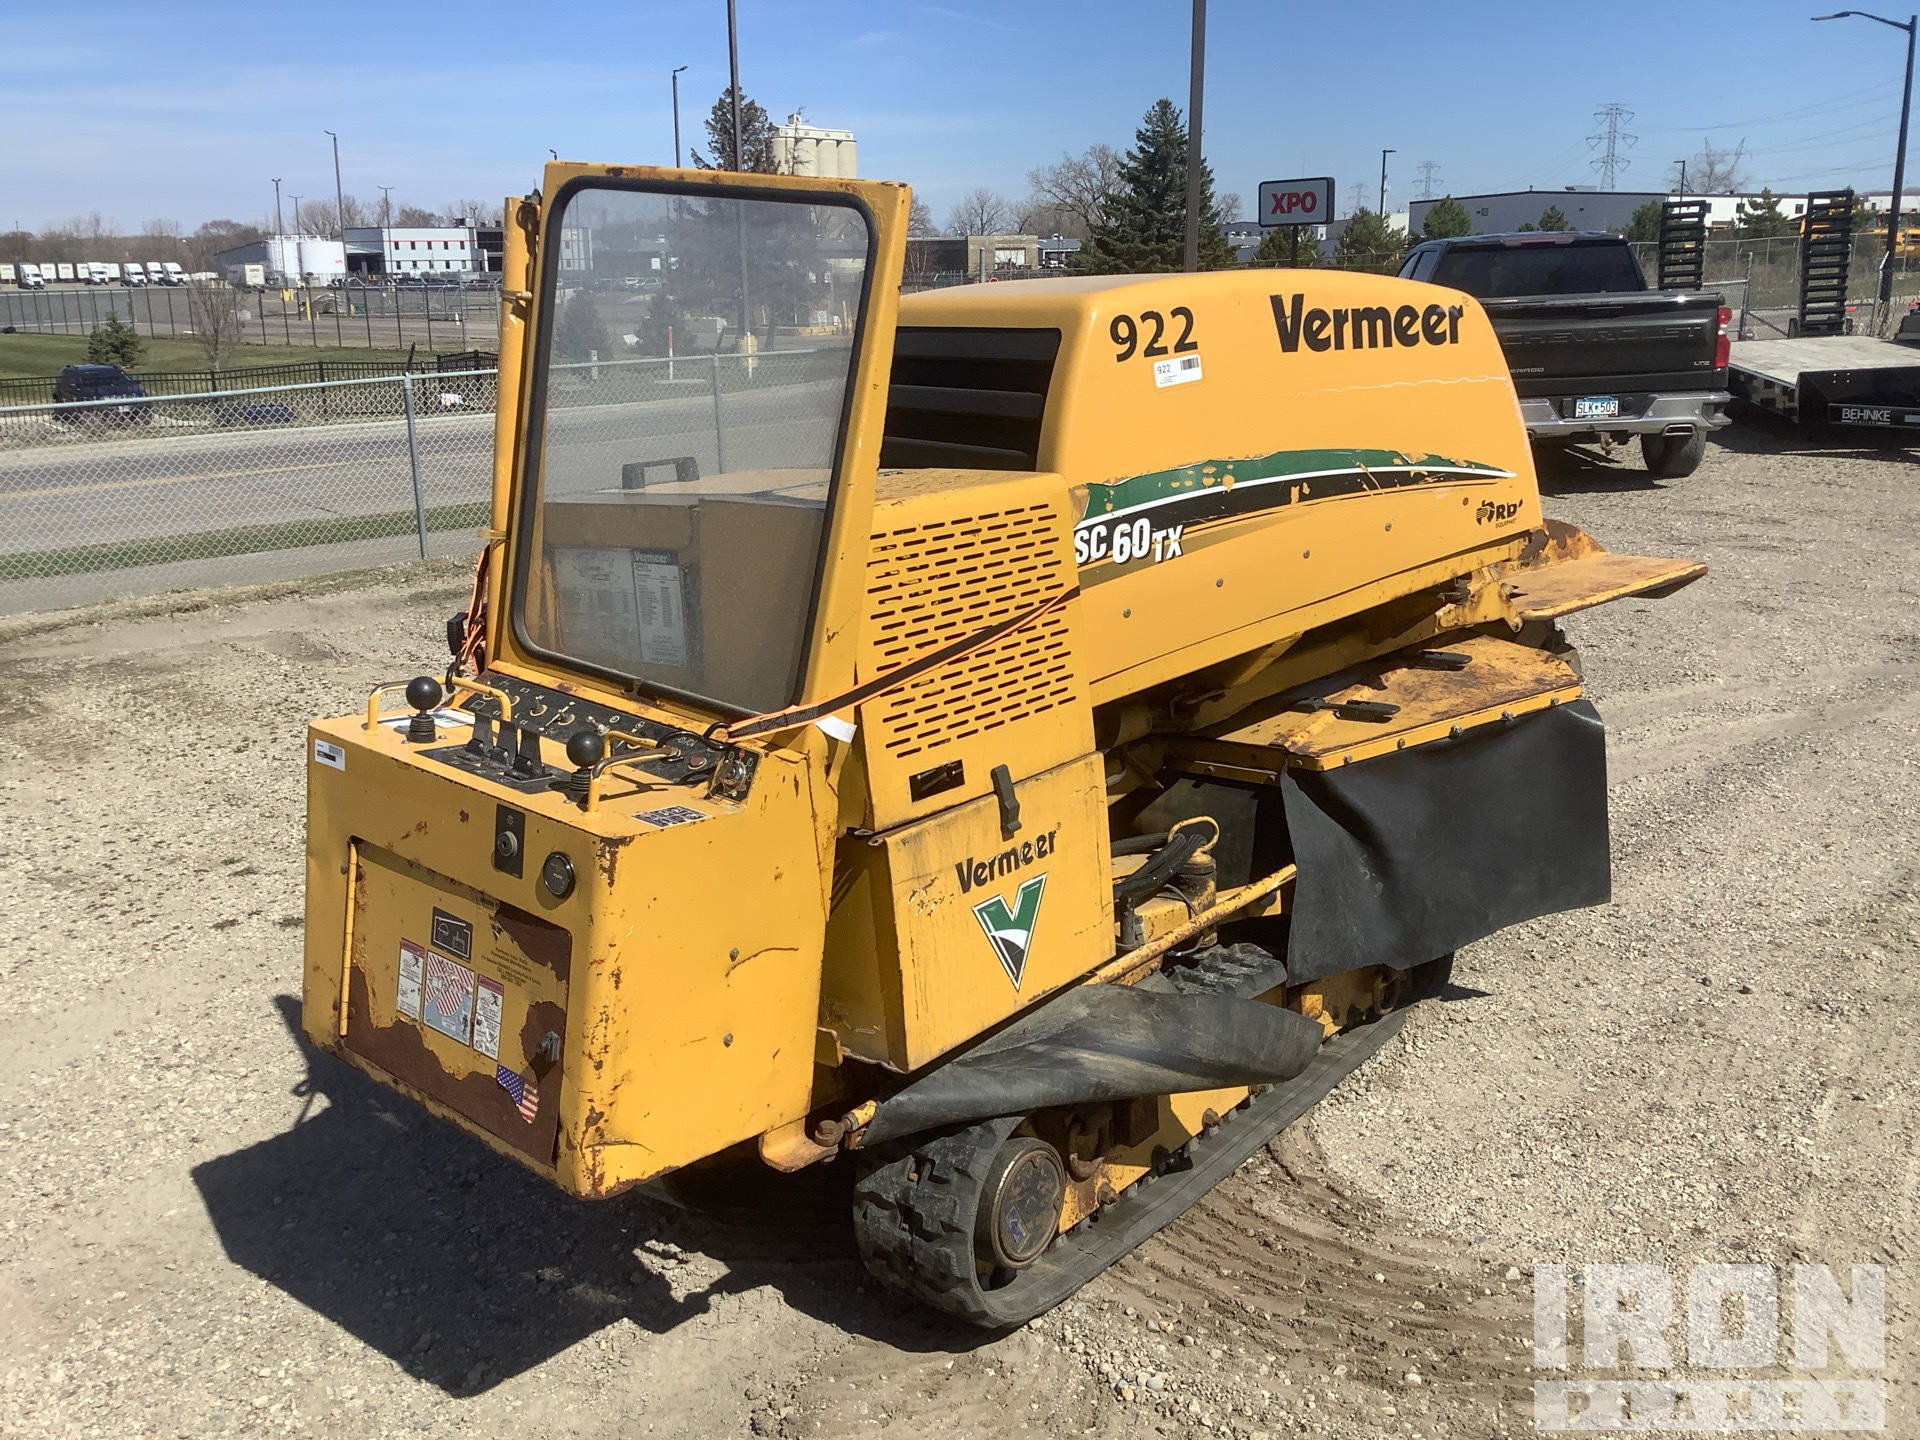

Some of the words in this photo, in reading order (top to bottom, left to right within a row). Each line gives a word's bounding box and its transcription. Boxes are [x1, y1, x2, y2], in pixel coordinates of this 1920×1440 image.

[1270, 191, 1317, 214] XPO
[1269, 293, 1464, 353] Vermeer
[1110, 306, 1198, 363] 922
[1503, 326, 1702, 346] CHEVROLET
[1157, 364, 1171, 375] 922
[1578, 402, 1594, 414] SLK
[1600, 402, 1617, 413] 503
[1842, 408, 1891, 421] BEHNKE
[634, 550, 668, 564] Vermeer
[955, 829, 1057, 894] Vermeer
